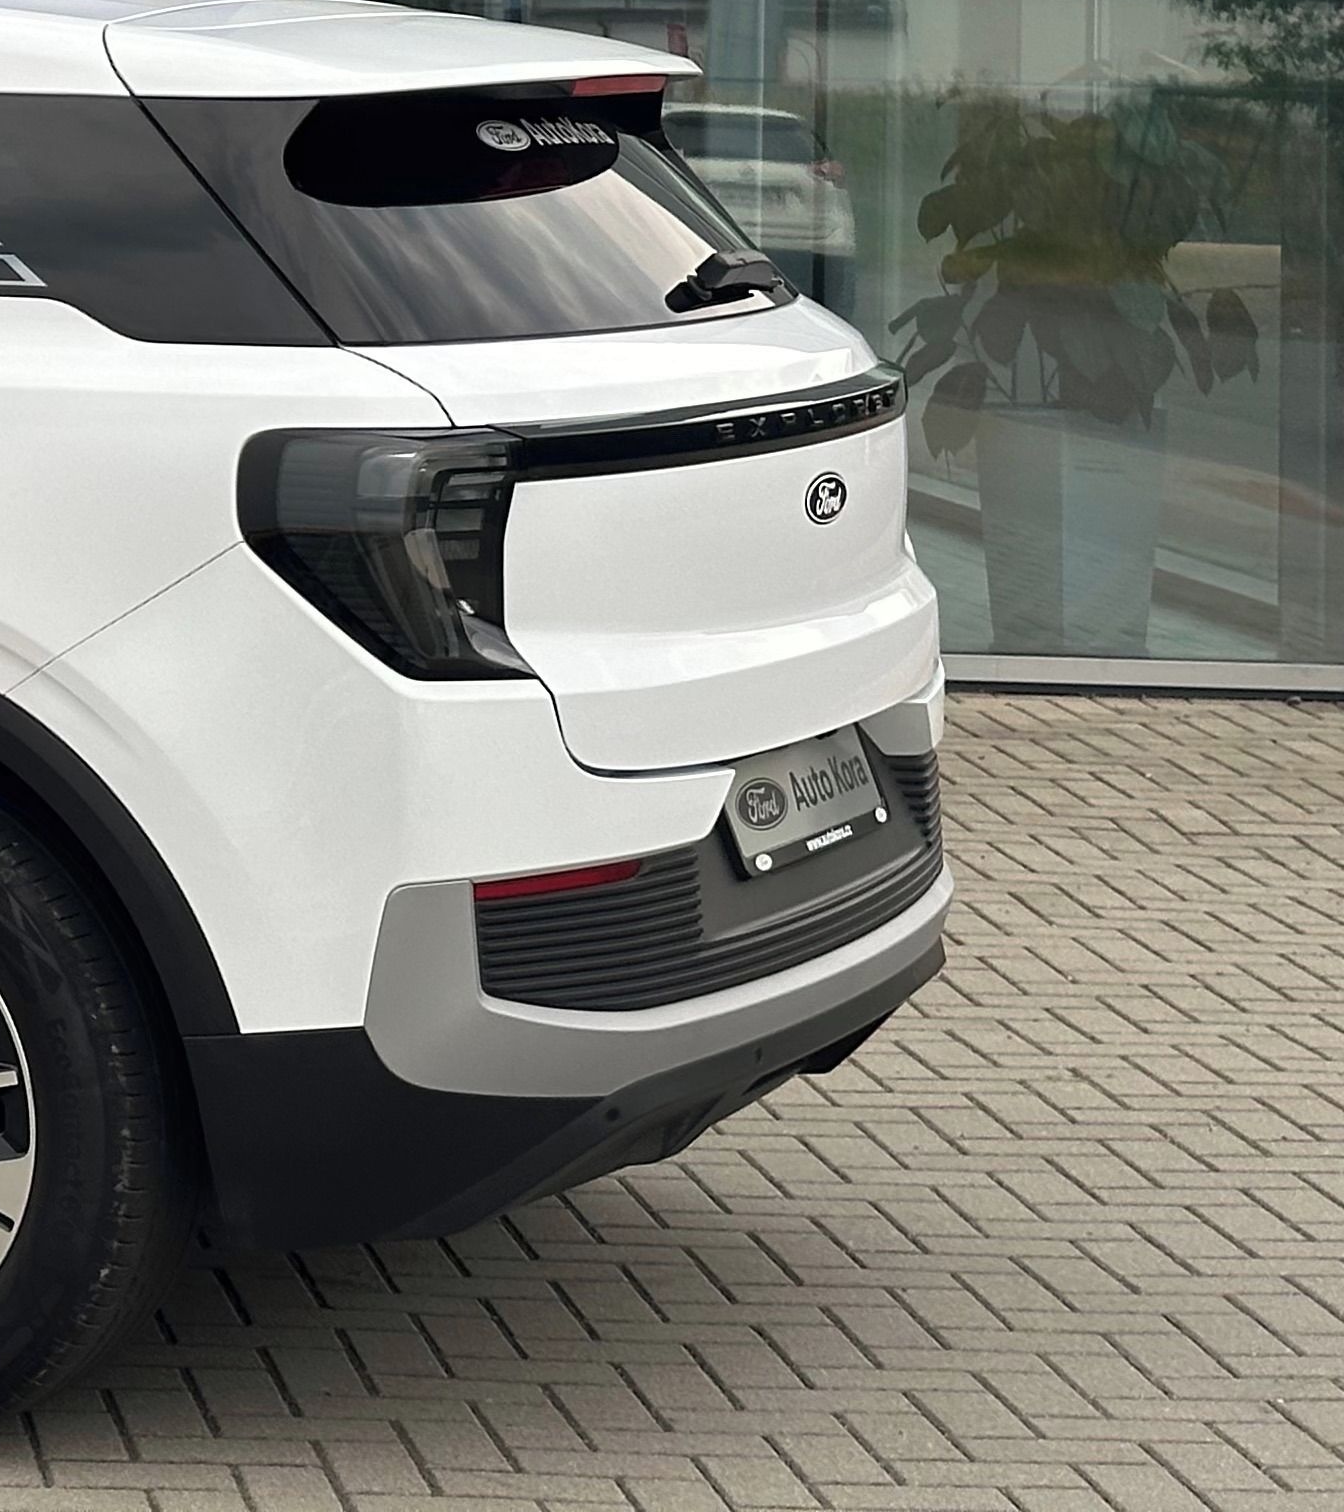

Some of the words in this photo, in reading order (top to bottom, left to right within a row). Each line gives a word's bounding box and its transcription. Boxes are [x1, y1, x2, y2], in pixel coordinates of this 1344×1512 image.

[486, 124, 522, 144] Ford
[815, 480, 842, 516] Ford
[788, 767, 835, 812] Auto
[827, 754, 870, 796] Kora
[745, 786, 780, 824] Ford
